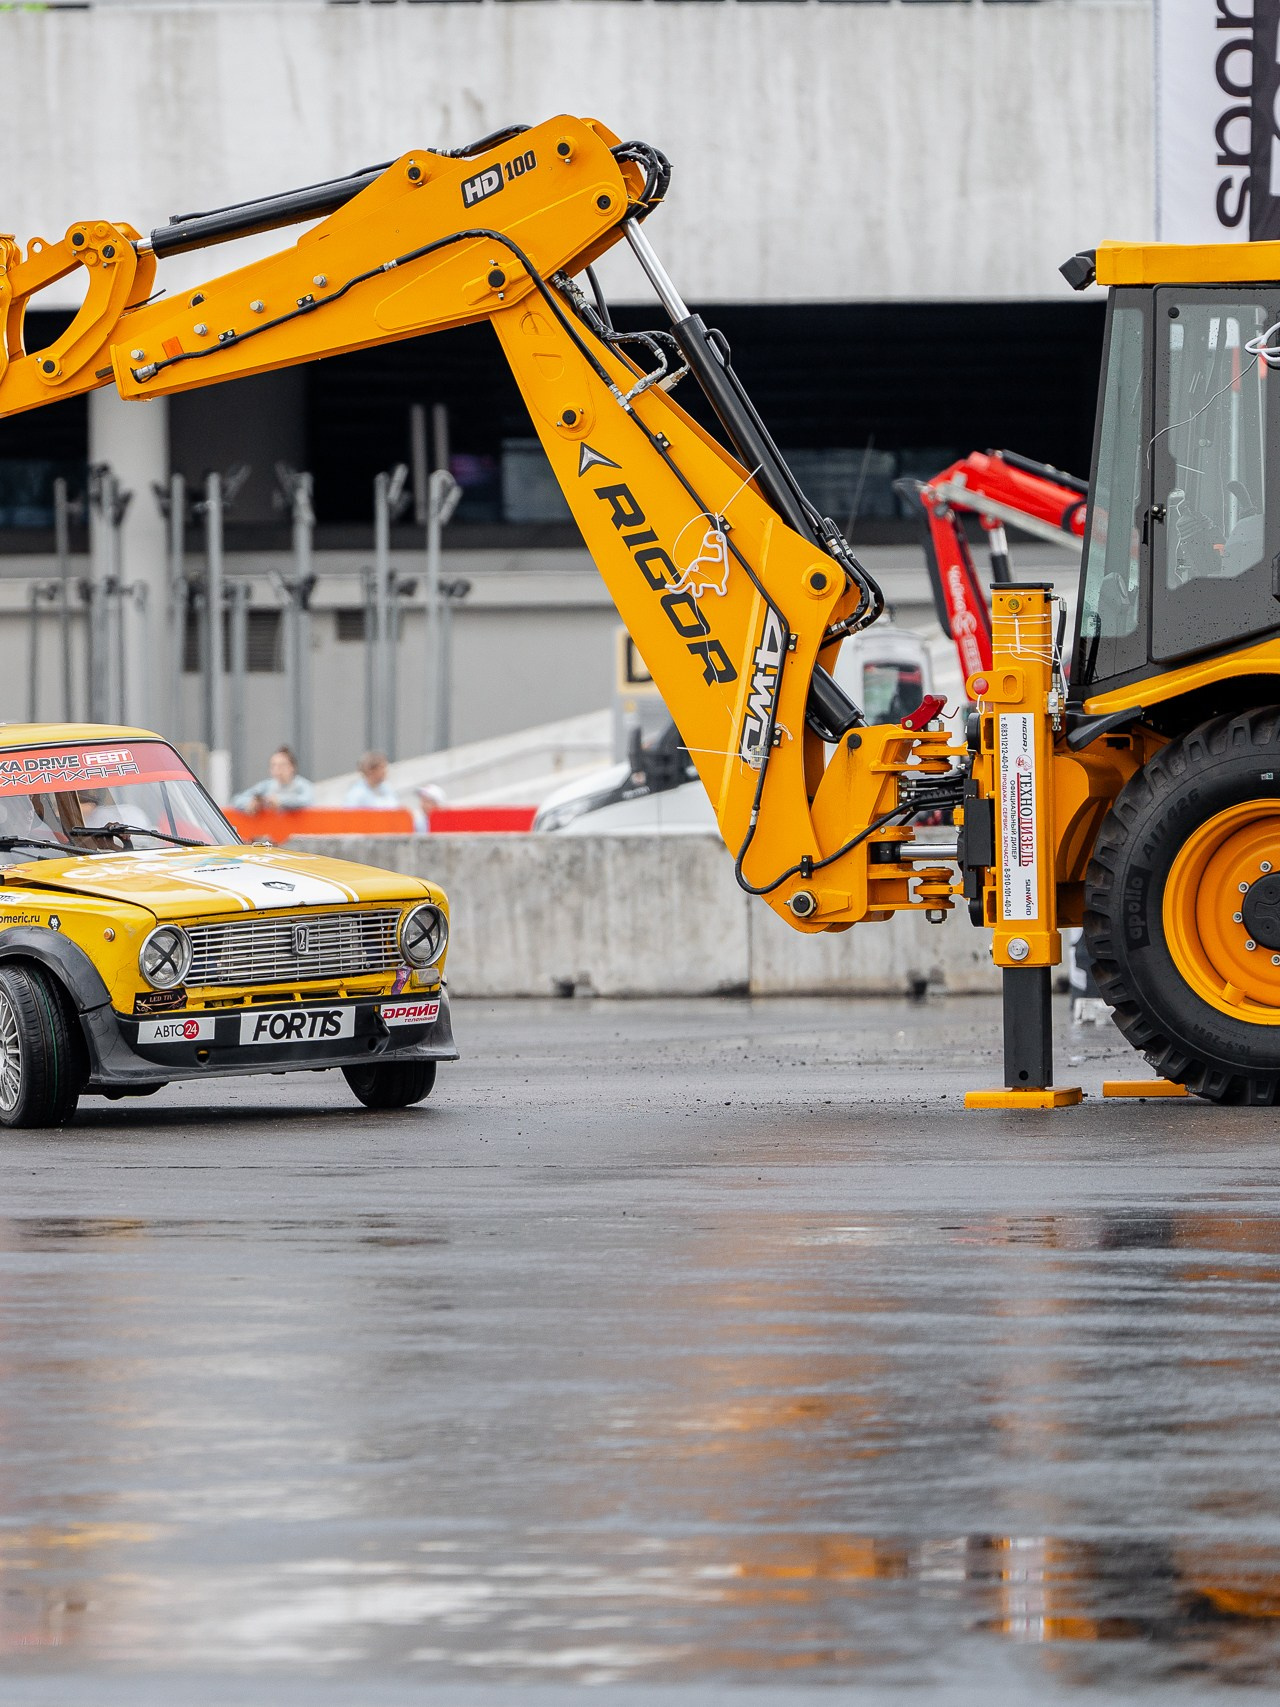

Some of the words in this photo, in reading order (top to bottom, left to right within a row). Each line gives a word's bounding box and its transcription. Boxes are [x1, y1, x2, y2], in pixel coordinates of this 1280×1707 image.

[465, 170, 500, 203] HD
[505, 150, 537, 181] 100
[593, 482, 738, 687] RIGOR
[24, 755, 80, 771] DRIVE
[87, 751, 129, 765] FEST
[1020, 771, 1034, 867] ТЕХНОДИЗЕЛЬ
[1025, 879, 1034, 916] SUNWARD
[1125, 876, 1146, 940] apollo
[252, 1010, 344, 1042] FORTIS
[383, 1003, 439, 1019] ДРАЙВ
